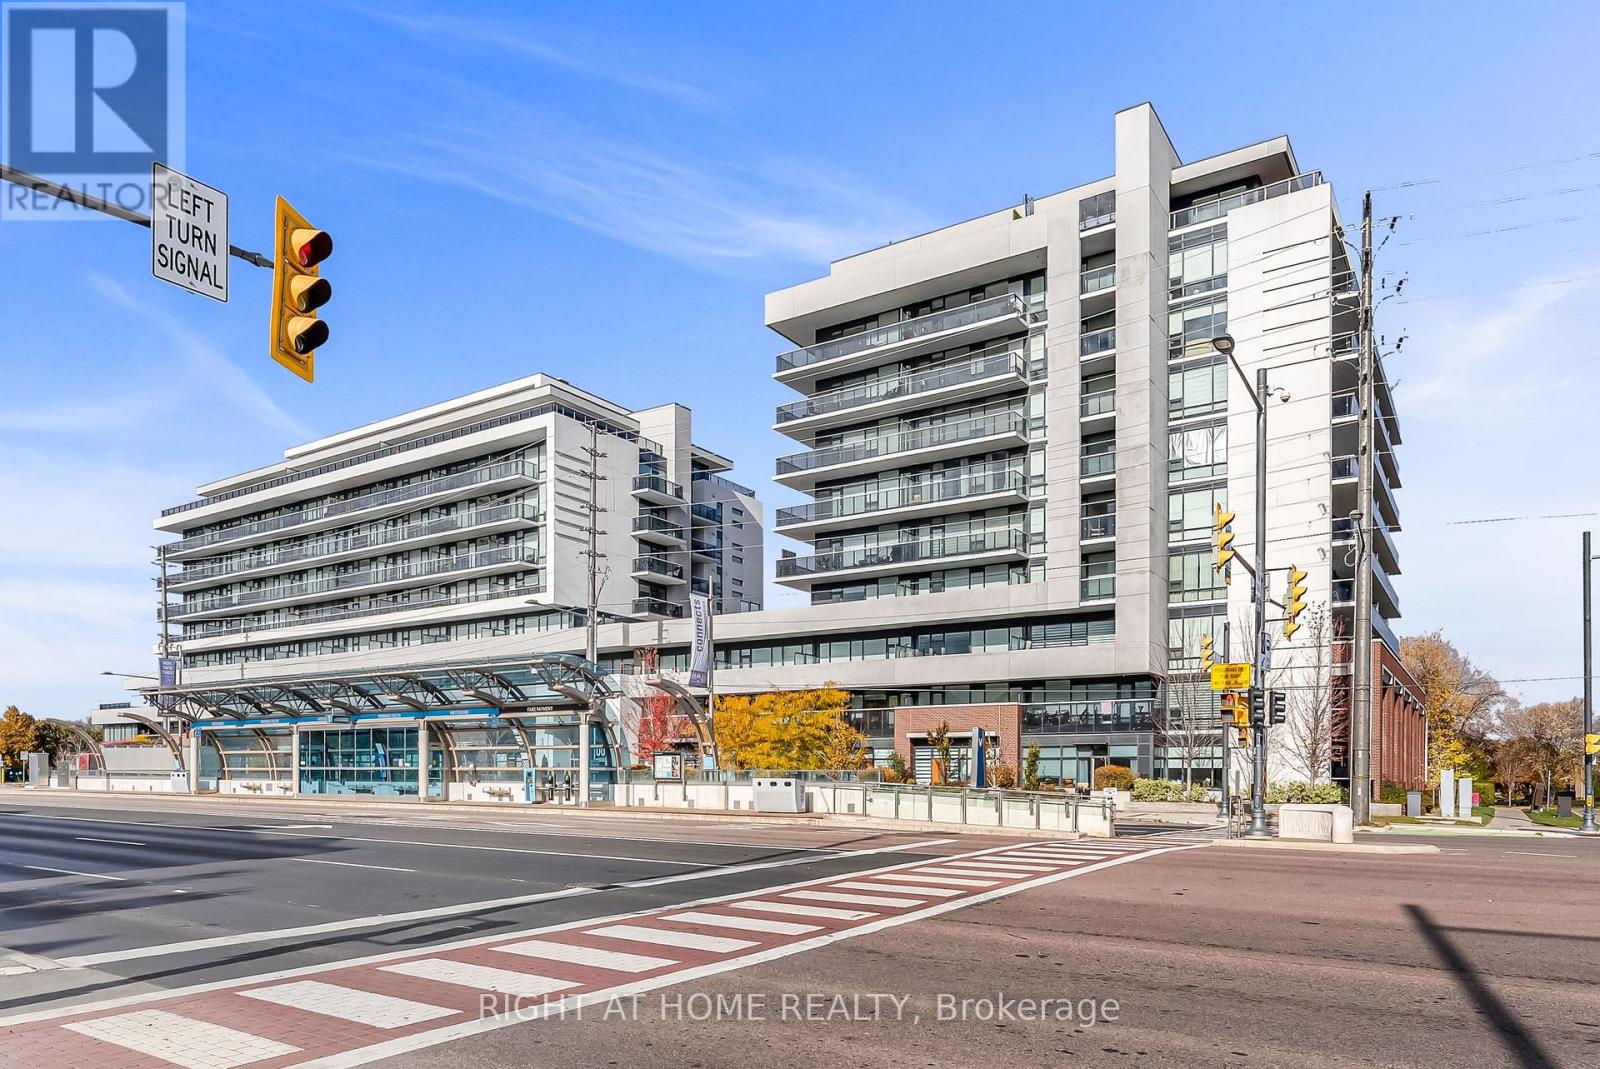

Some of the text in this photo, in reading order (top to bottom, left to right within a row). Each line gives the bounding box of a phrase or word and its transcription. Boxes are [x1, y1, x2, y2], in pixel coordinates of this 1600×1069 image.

[166, 182, 214, 223] LEFT
[165, 213, 217, 257] TURN
[157, 243, 224, 290] SIGNAL
[694, 598, 704, 652] connects
